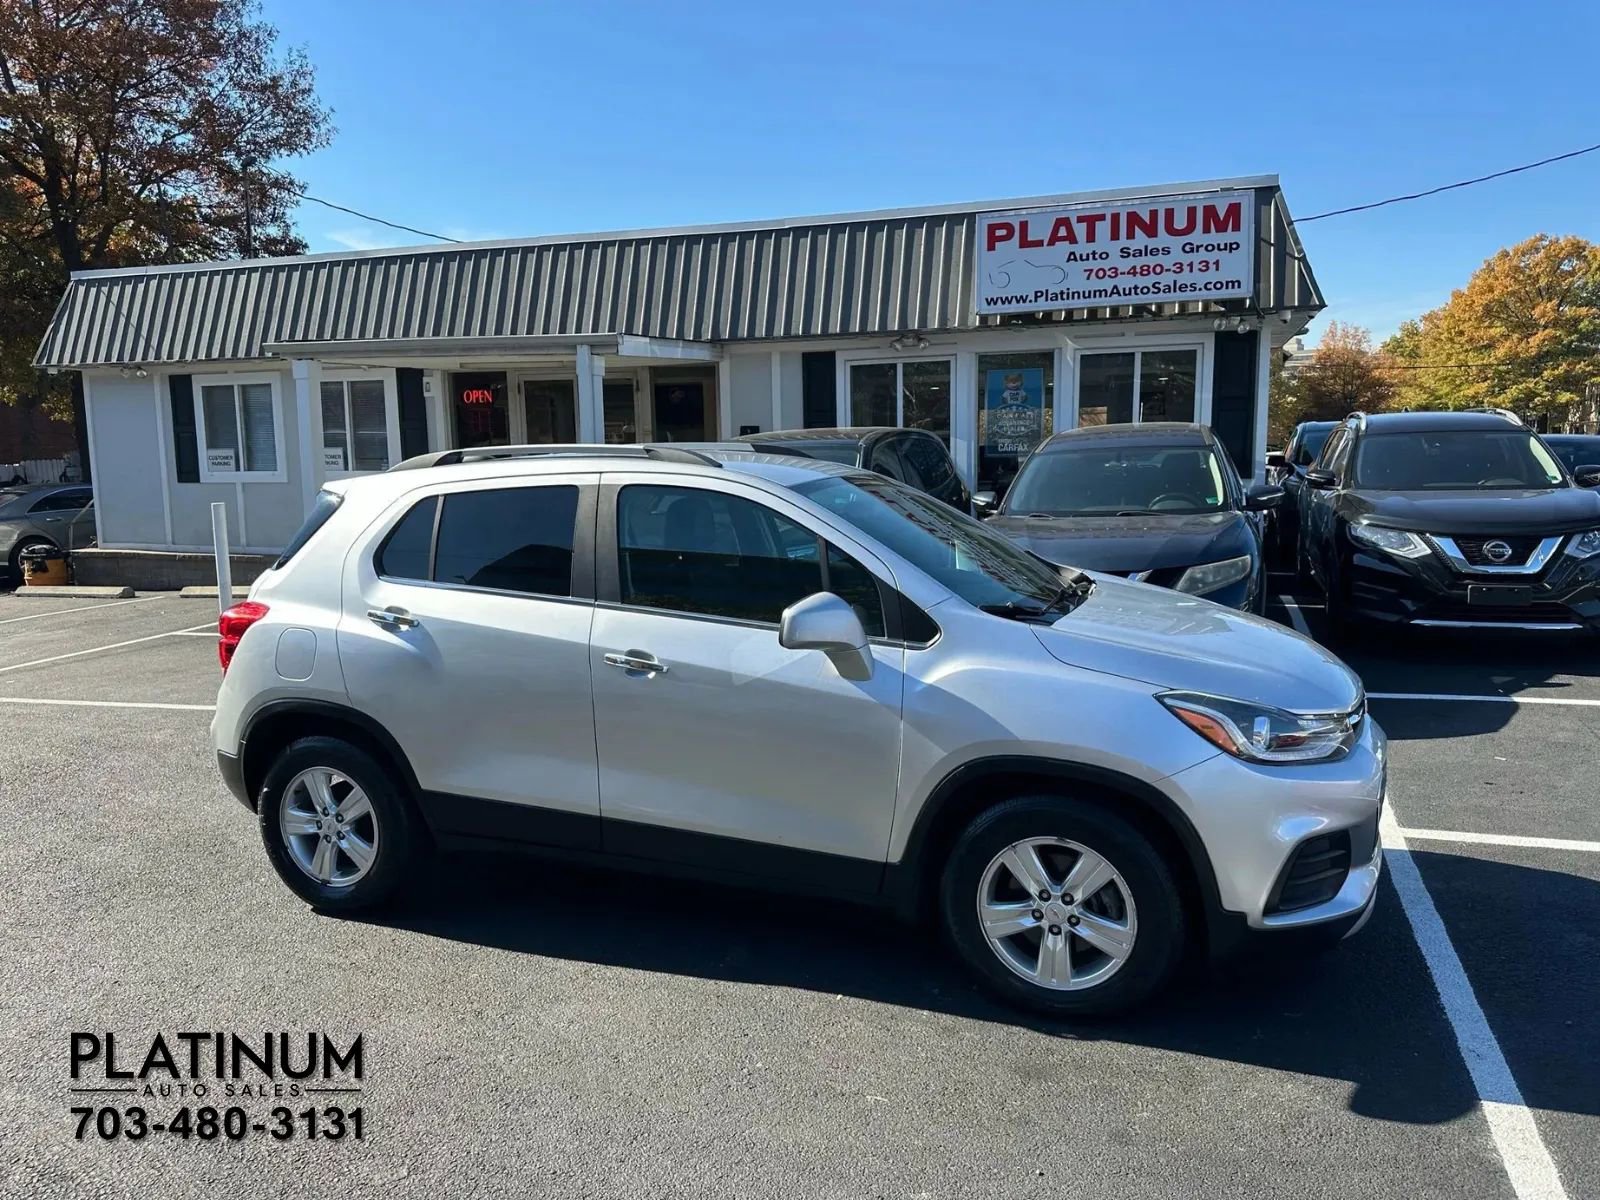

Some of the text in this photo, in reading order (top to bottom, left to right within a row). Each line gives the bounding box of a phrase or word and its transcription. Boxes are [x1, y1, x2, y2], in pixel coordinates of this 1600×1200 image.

[986, 202, 1242, 252] PLATINUM
[1066, 239, 1241, 263] Auto Sales Group
[1083, 260, 1221, 281] 703-480-3131
[985, 279, 1242, 307] www.PlatinumAutoSales.com
[463, 389, 493, 404] OPEN
[998, 443, 1028, 452] CARFAX
